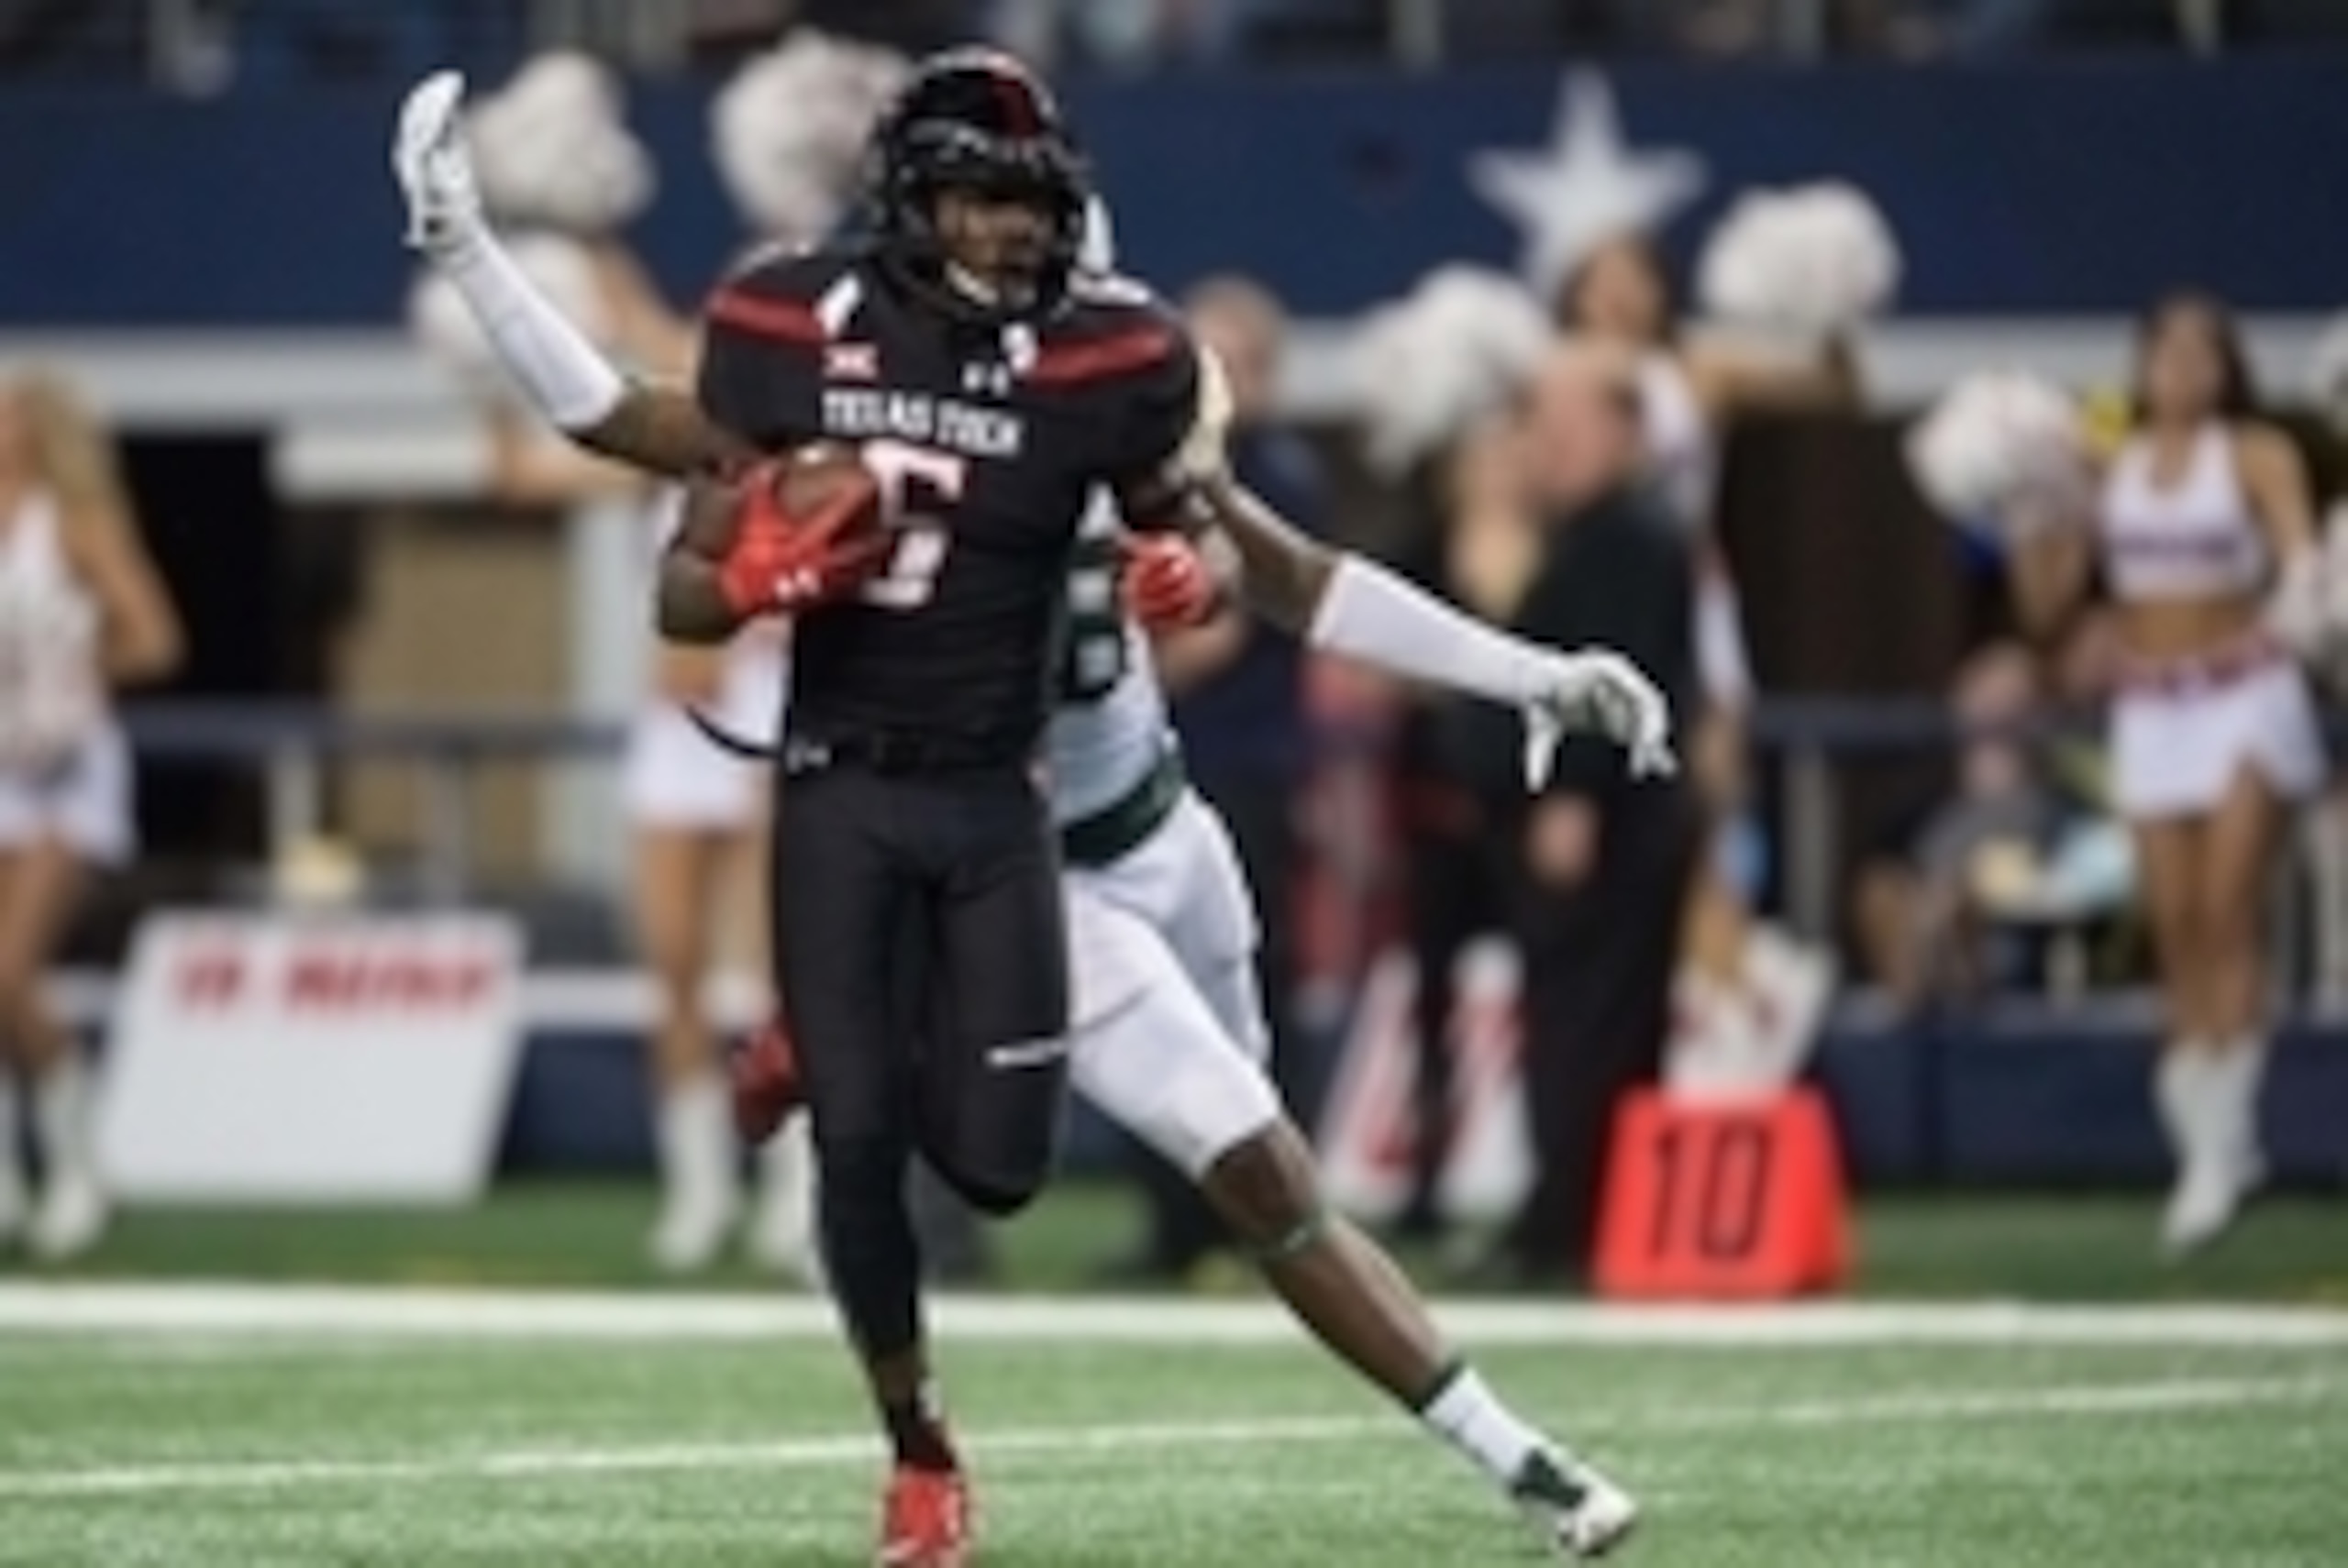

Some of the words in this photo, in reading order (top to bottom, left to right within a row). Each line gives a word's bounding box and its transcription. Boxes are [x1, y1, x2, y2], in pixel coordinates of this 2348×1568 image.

[822, 388, 933, 440] TEXAS
[936, 398, 1024, 457] TECH
[1645, 1114, 1773, 1265] 10
